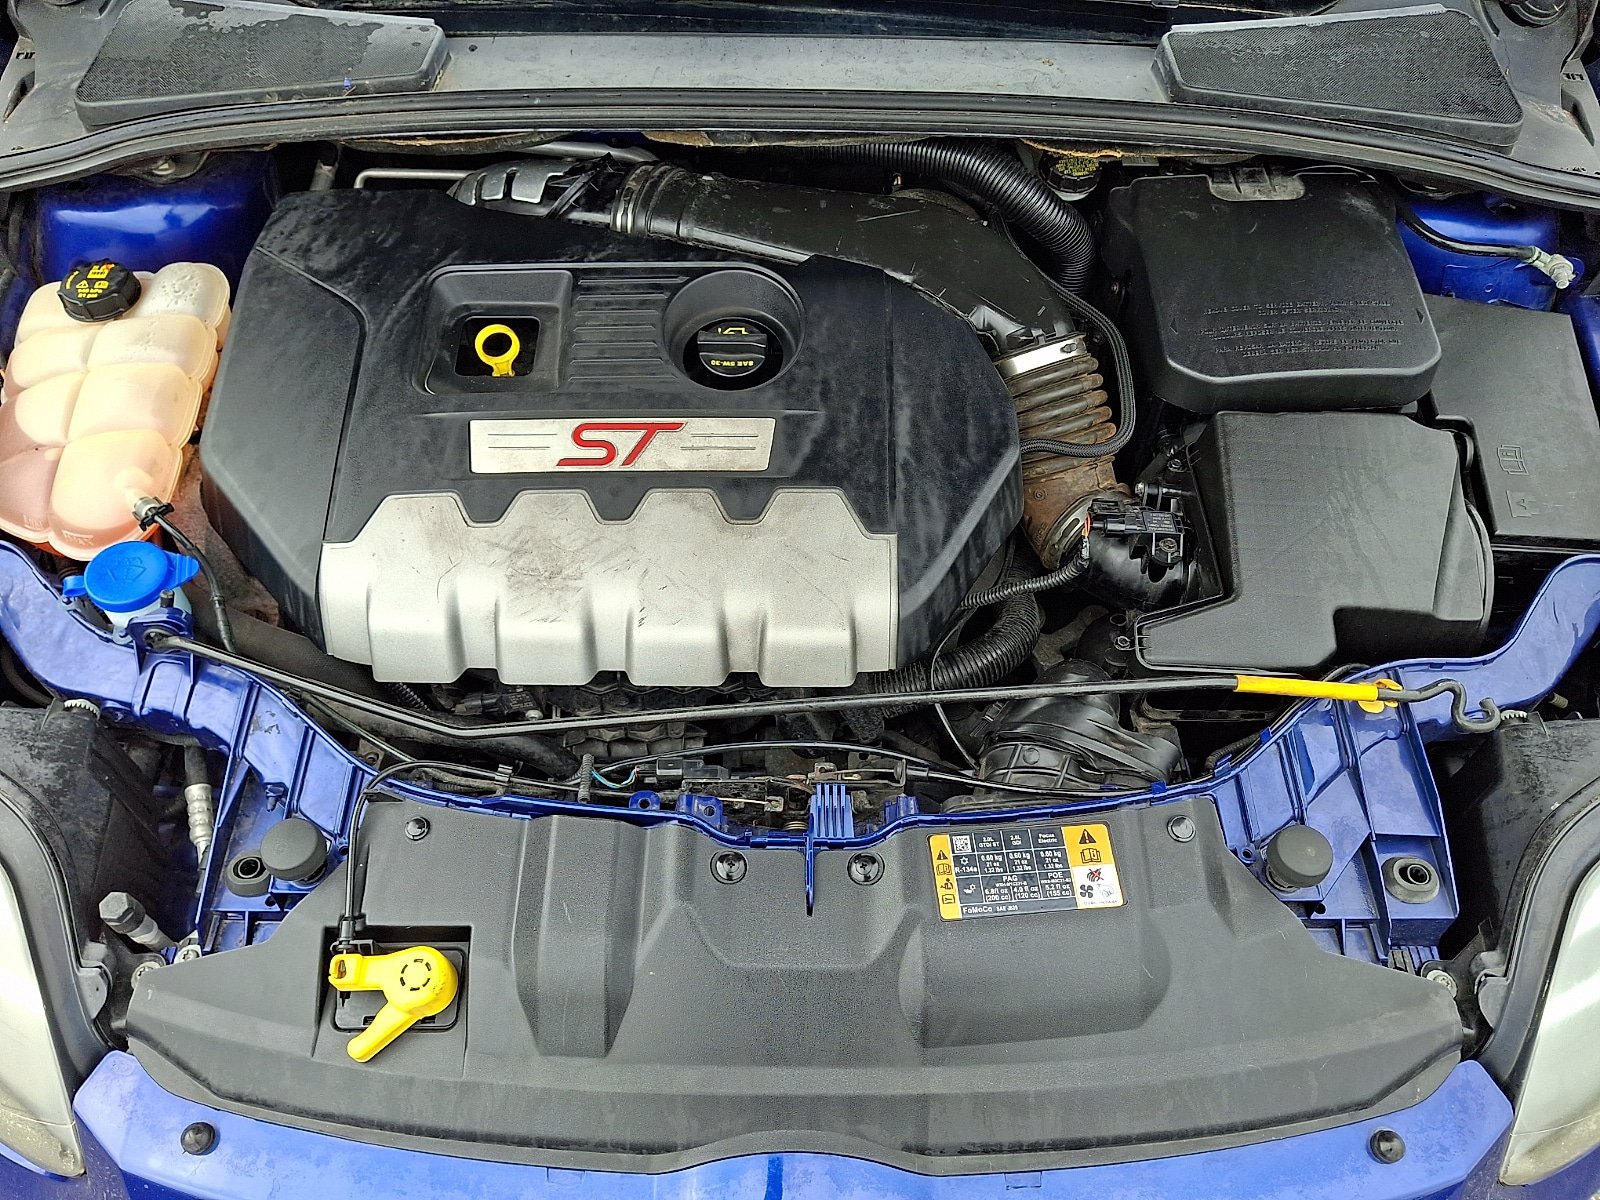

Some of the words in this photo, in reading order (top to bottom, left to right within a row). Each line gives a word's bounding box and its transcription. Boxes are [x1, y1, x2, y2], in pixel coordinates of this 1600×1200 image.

[710, 359, 736, 367] 5W-30
[555, 422, 684, 467] ST
[1022, 852, 1031, 860] kg
[1053, 850, 1062, 858] kg
[985, 894, 1000, 903] (200
[1014, 892, 1029, 900] (120
[962, 906, 993, 914] FoMoCo
